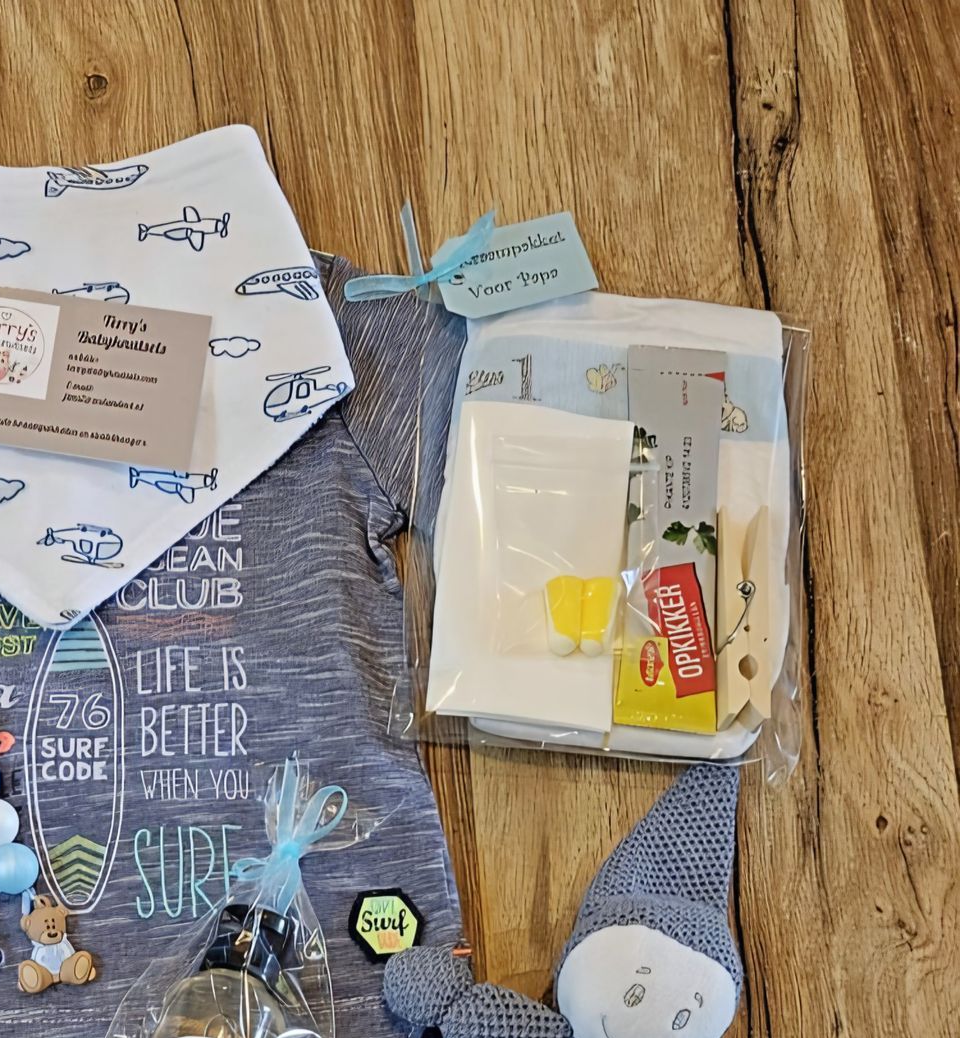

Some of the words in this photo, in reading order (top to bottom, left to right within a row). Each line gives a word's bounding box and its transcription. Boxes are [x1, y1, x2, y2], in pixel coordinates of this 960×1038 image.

[468, 280, 512, 299] Voor
[147, 546, 243, 572] EAN
[116, 577, 243, 610] CLUB
[654, 583, 704, 679] OPKIKKER
[137, 646, 202, 694] LIFE
[223, 647, 247, 691] IS
[49, 692, 111, 730] 76
[141, 703, 248, 757] BETTER
[41, 737, 109, 758] SURF
[41, 760, 108, 781] CODE
[141, 768, 199, 800] WHEN
[210, 768, 249, 800] YOU
[134, 825, 242, 919] SURF
